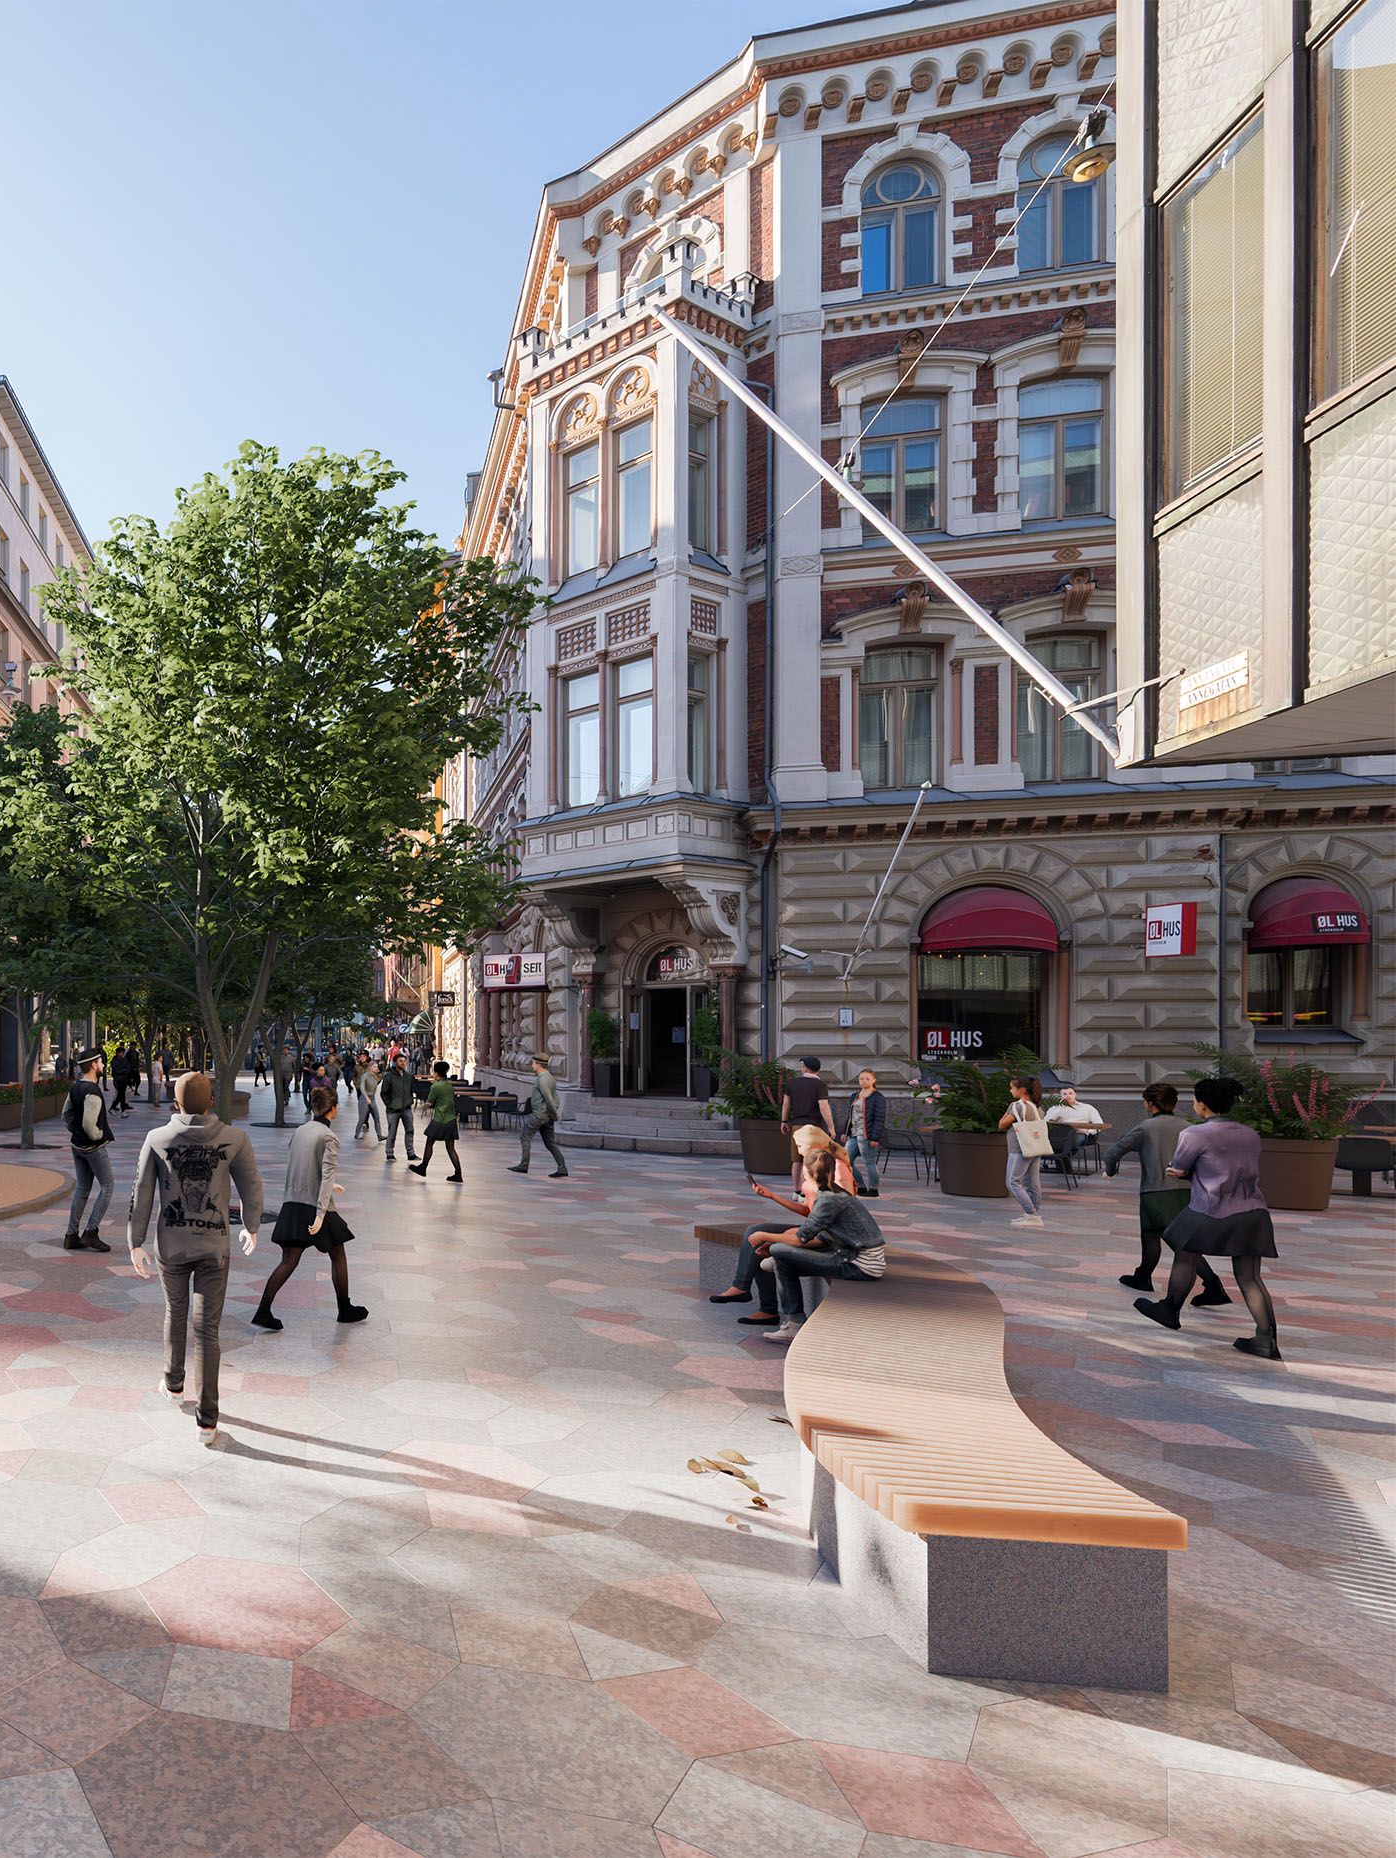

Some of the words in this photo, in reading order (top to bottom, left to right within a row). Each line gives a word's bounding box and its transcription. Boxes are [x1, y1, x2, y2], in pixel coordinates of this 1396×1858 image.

[1162, 920, 1181, 937] HUS
[1316, 915, 1335, 928] ØL
[1336, 914, 1359, 927] HUS
[674, 957, 693, 970] HUS
[927, 1031, 947, 1048] ØL
[950, 1031, 983, 1048] HUS
